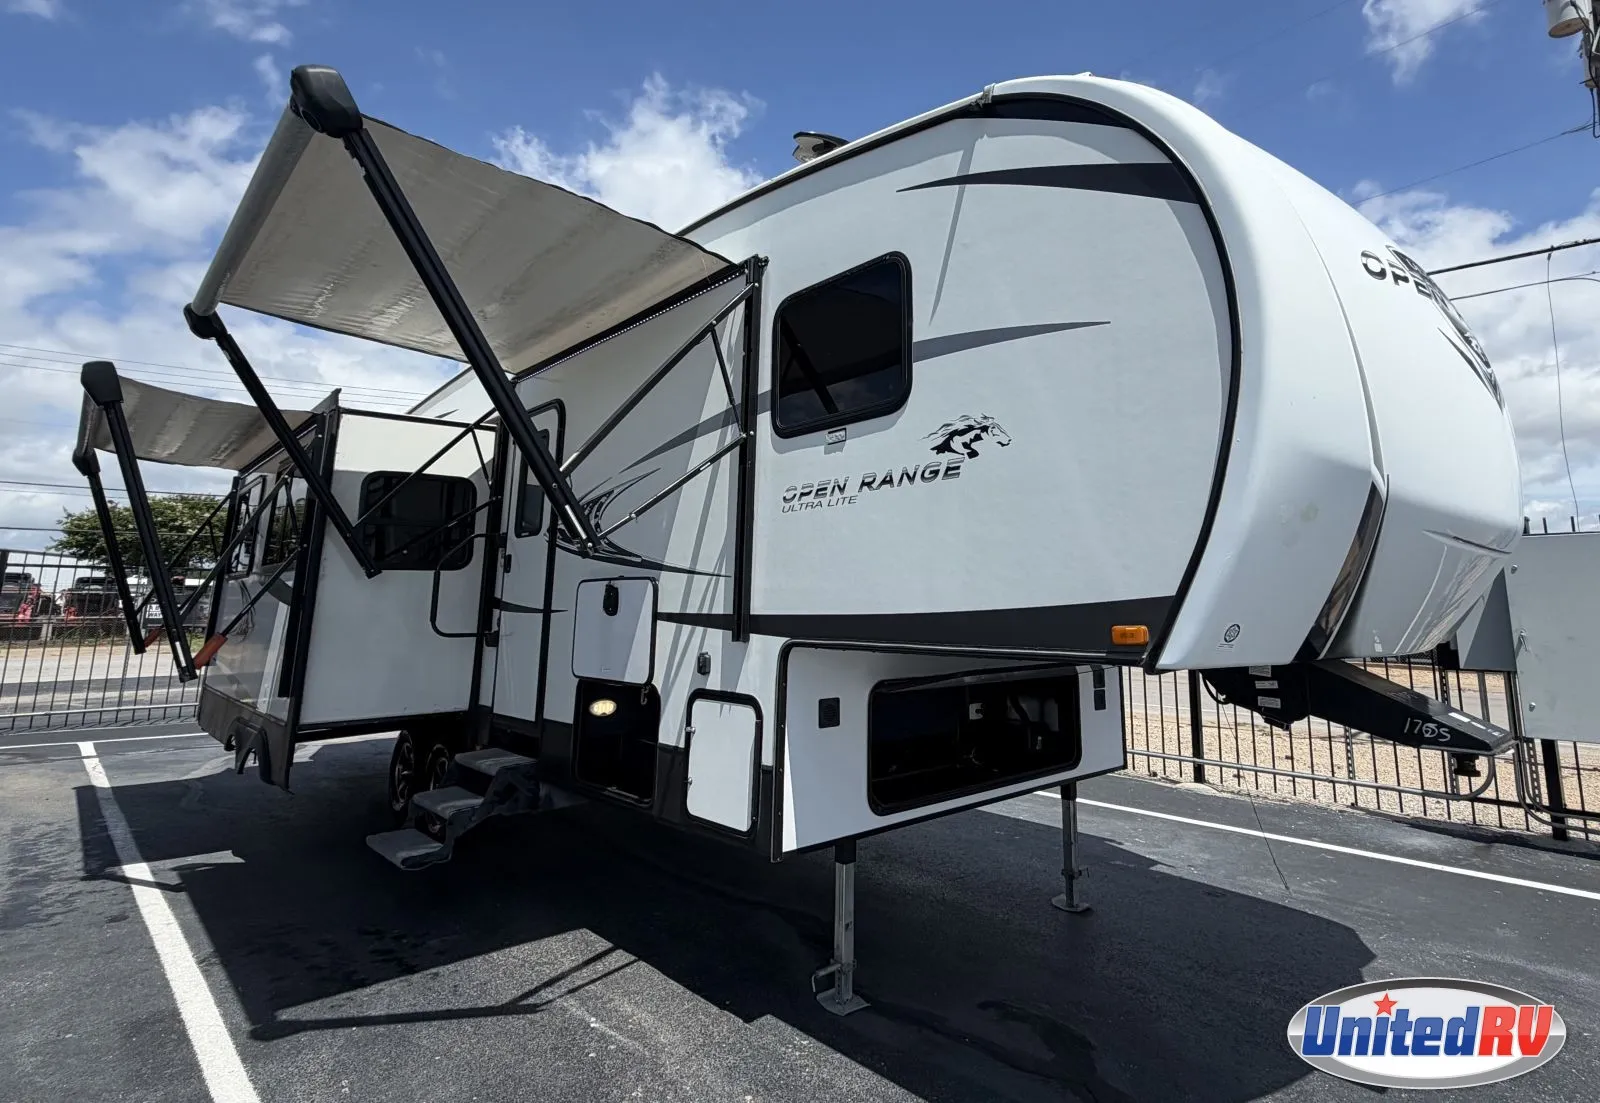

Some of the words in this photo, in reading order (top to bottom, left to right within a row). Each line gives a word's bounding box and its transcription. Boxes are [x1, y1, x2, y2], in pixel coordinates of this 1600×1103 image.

[782, 476, 849, 504] OPEN
[858, 457, 965, 493] RANGE
[782, 500, 823, 514] ULTRA
[827, 495, 858, 508] LITE
